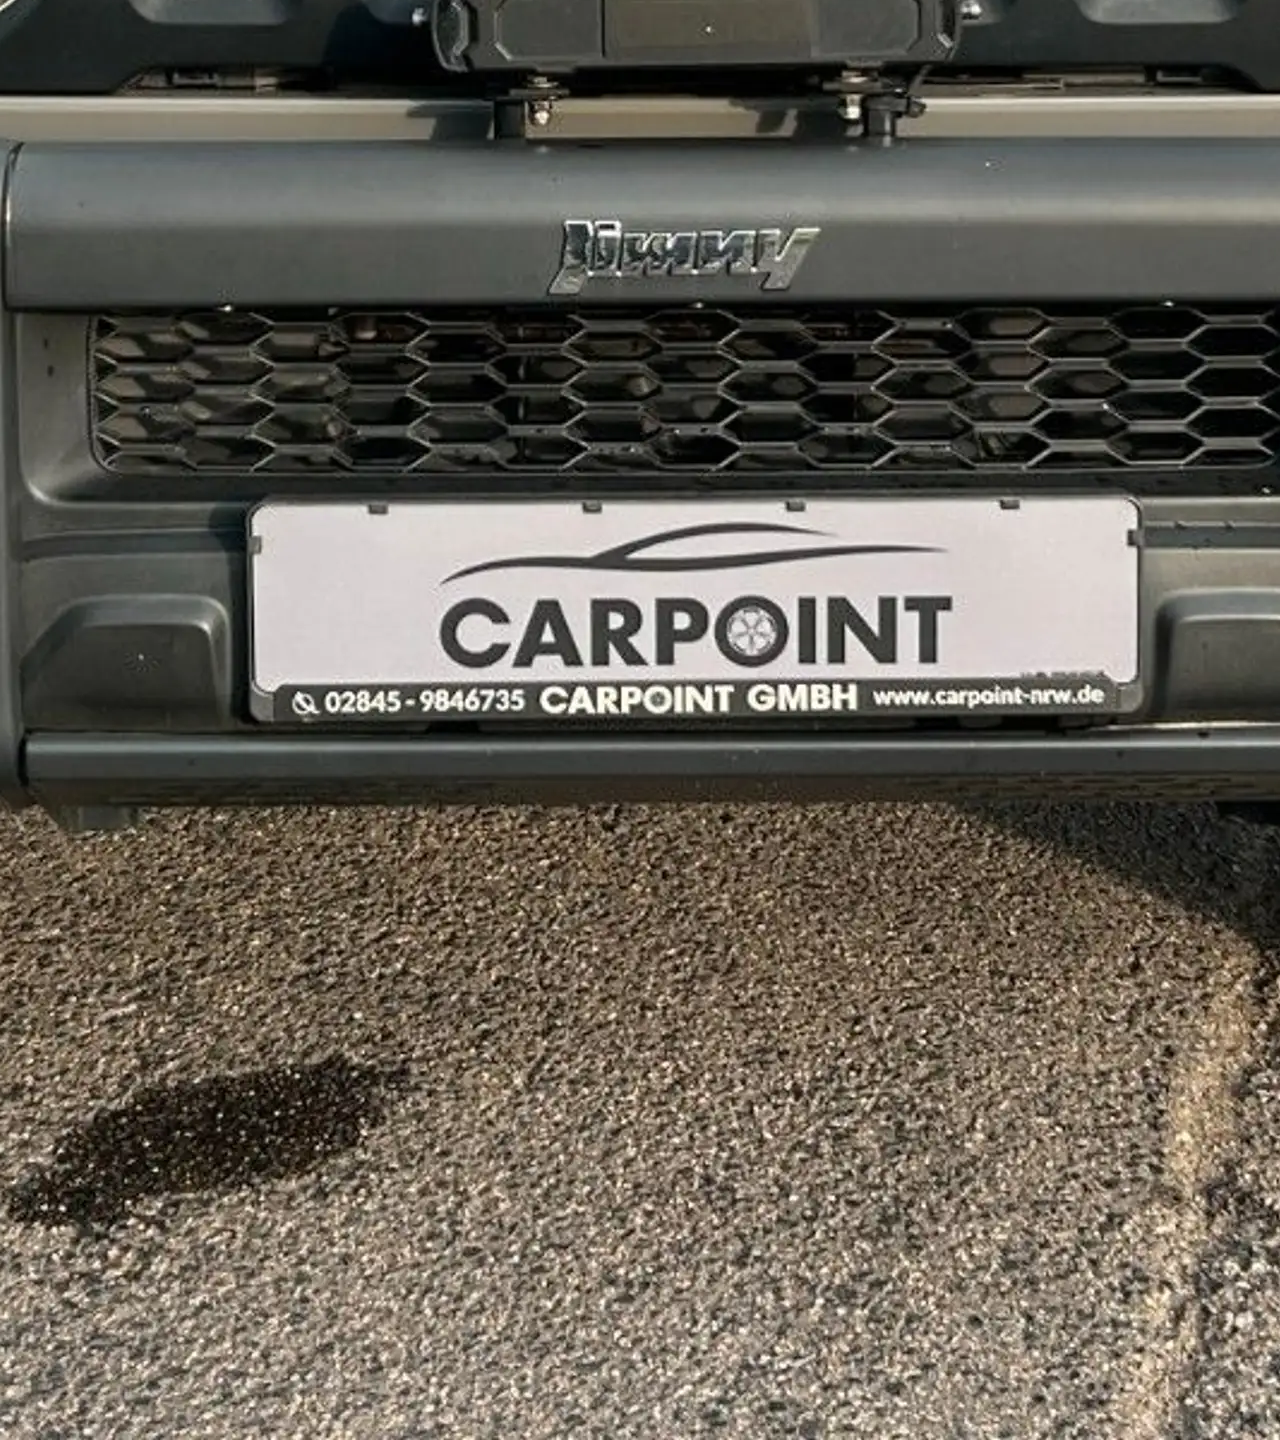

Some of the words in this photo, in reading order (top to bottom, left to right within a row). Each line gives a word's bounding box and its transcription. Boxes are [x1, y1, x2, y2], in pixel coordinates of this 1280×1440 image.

[439, 595, 953, 668] CARPOINT
[539, 685, 734, 716] CARPOINT
[747, 684, 858, 712] GMBH
[873, 684, 1106, 709] www.carpoint-nrw.de
